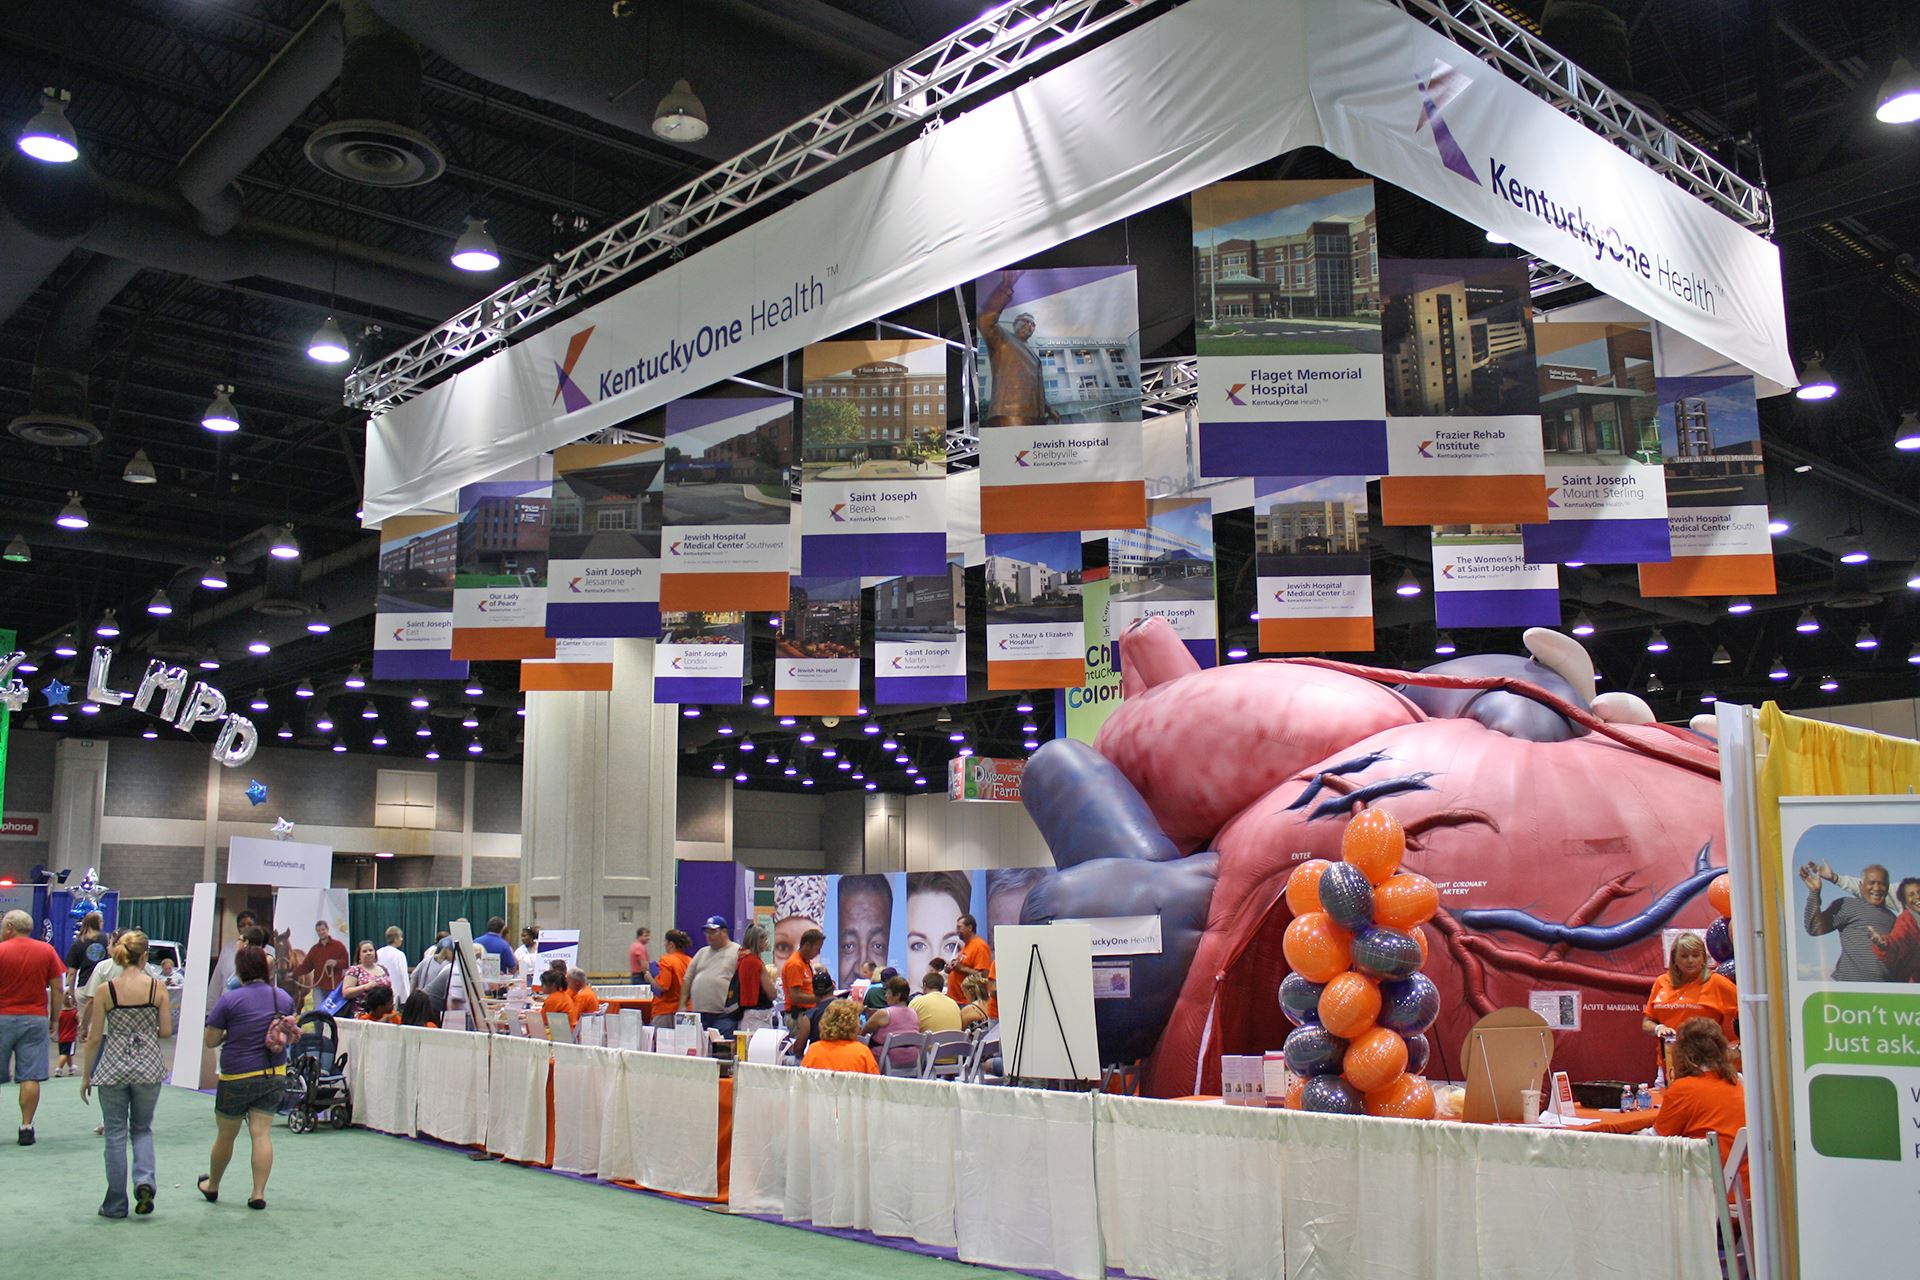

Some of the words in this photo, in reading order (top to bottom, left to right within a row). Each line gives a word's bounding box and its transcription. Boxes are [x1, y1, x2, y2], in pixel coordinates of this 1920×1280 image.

[1490, 157, 1650, 279] KentuckyOne
[1656, 253, 1716, 316] Health
[600, 319, 743, 401] KentuckyOne
[751, 275, 824, 336] Health
[1250, 369, 1293, 384] Flaget
[1297, 368, 1362, 380] Memorial
[1251, 383, 1308, 397] Hospital
[1252, 399, 1299, 407] KentuckyOne
[1436, 430, 1470, 439] Frazier
[1473, 429, 1505, 439] Rehab
[1033, 440, 1065, 449] Jewish
[1068, 438, 1109, 448] Hospital
[1436, 441, 1480, 450] Institute
[1032, 449, 1078, 460] Shelbyville
[1562, 475, 1592, 486] Saint
[1596, 475, 1636, 487] Joseph
[850, 492, 877, 502] Saint
[880, 491, 917, 503] Joseph
[1563, 488, 1599, 499] Mount
[1603, 487, 1644, 500] Sterling
[849, 504, 876, 513] Berea
[1669, 515, 1694, 523] ewish
[1696, 514, 1731, 524] Hospital
[1732, 523, 1755, 531] South
[684, 533, 711, 541] Jewish
[712, 533, 746, 541] Hospital
[683, 541, 715, 550] Medical
[717, 541, 744, 549] Center
[745, 541, 784, 549] Southwest
[1456, 556, 1472, 564] The
[1474, 555, 1513, 563] Women's
[585, 568, 608, 576] Saint
[610, 567, 642, 577] Joseph
[1492, 564, 1520, 573] Joseph
[585, 578, 625, 586] Jessamine
[1144, 609, 1164, 617] Saint
[1167, 608, 1195, 617] Joseph
[427, 620, 451, 628] Joseph
[704, 650, 728, 658] Joseph
[925, 648, 950, 656] Joseph
[974, 765, 1022, 786] Discovery
[993, 783, 1020, 799] Farm
[1291, 851, 1312, 860] ENTER
[1433, 881, 1450, 889] IGHT
[1452, 880, 1487, 888] CORONARY
[1092, 937, 1128, 947] uckyOne
[1130, 936, 1155, 944] Health
[1582, 1003, 1604, 1011] ACUTE
[1823, 1004, 1888, 1025] Don't
[1824, 1032, 1870, 1053] Just
[1876, 1034, 1920, 1055] ask.
